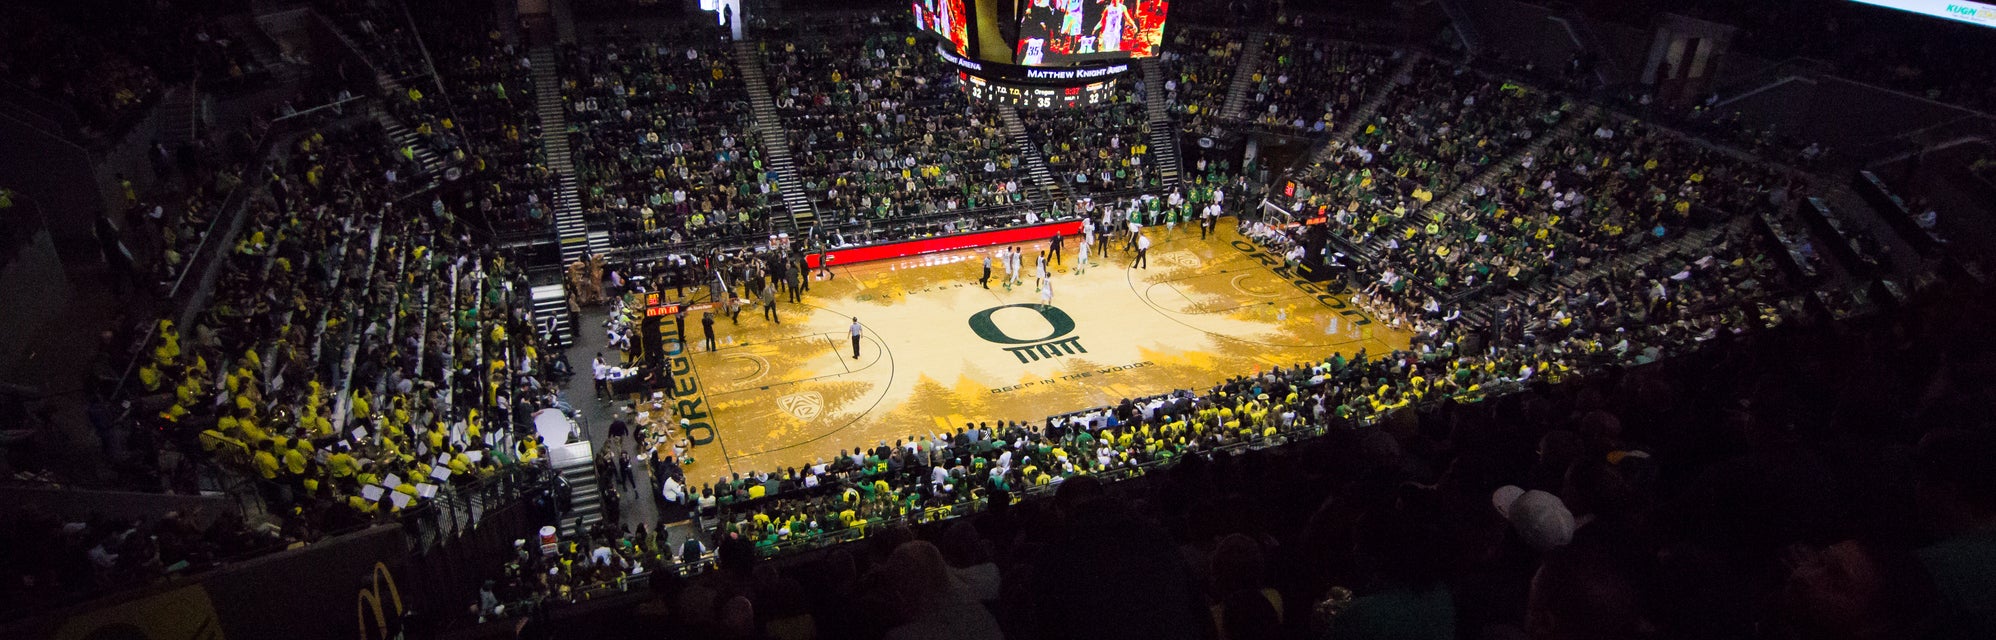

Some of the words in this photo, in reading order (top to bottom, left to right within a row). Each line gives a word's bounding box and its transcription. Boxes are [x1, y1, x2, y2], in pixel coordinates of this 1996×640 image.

[1946, 4, 1978, 16] KUGN
[1028, 46, 1039, 56] 35
[1027, 69, 1074, 79] MATTHEW
[1076, 68, 1106, 78] KNIGHT
[1106, 64, 1128, 75] ARENA
[972, 86, 982, 99] 32
[1037, 97, 1051, 108] 35
[1089, 93, 1099, 104] 32
[660, 319, 715, 446] OREGON
[991, 382, 1034, 394] DEEP
[1041, 377, 1056, 386] IN
[1059, 371, 1093, 381] THE
[1097, 360, 1155, 375] WOODS
[798, 406, 814, 416] 12
[877, 462, 888, 472] 24
